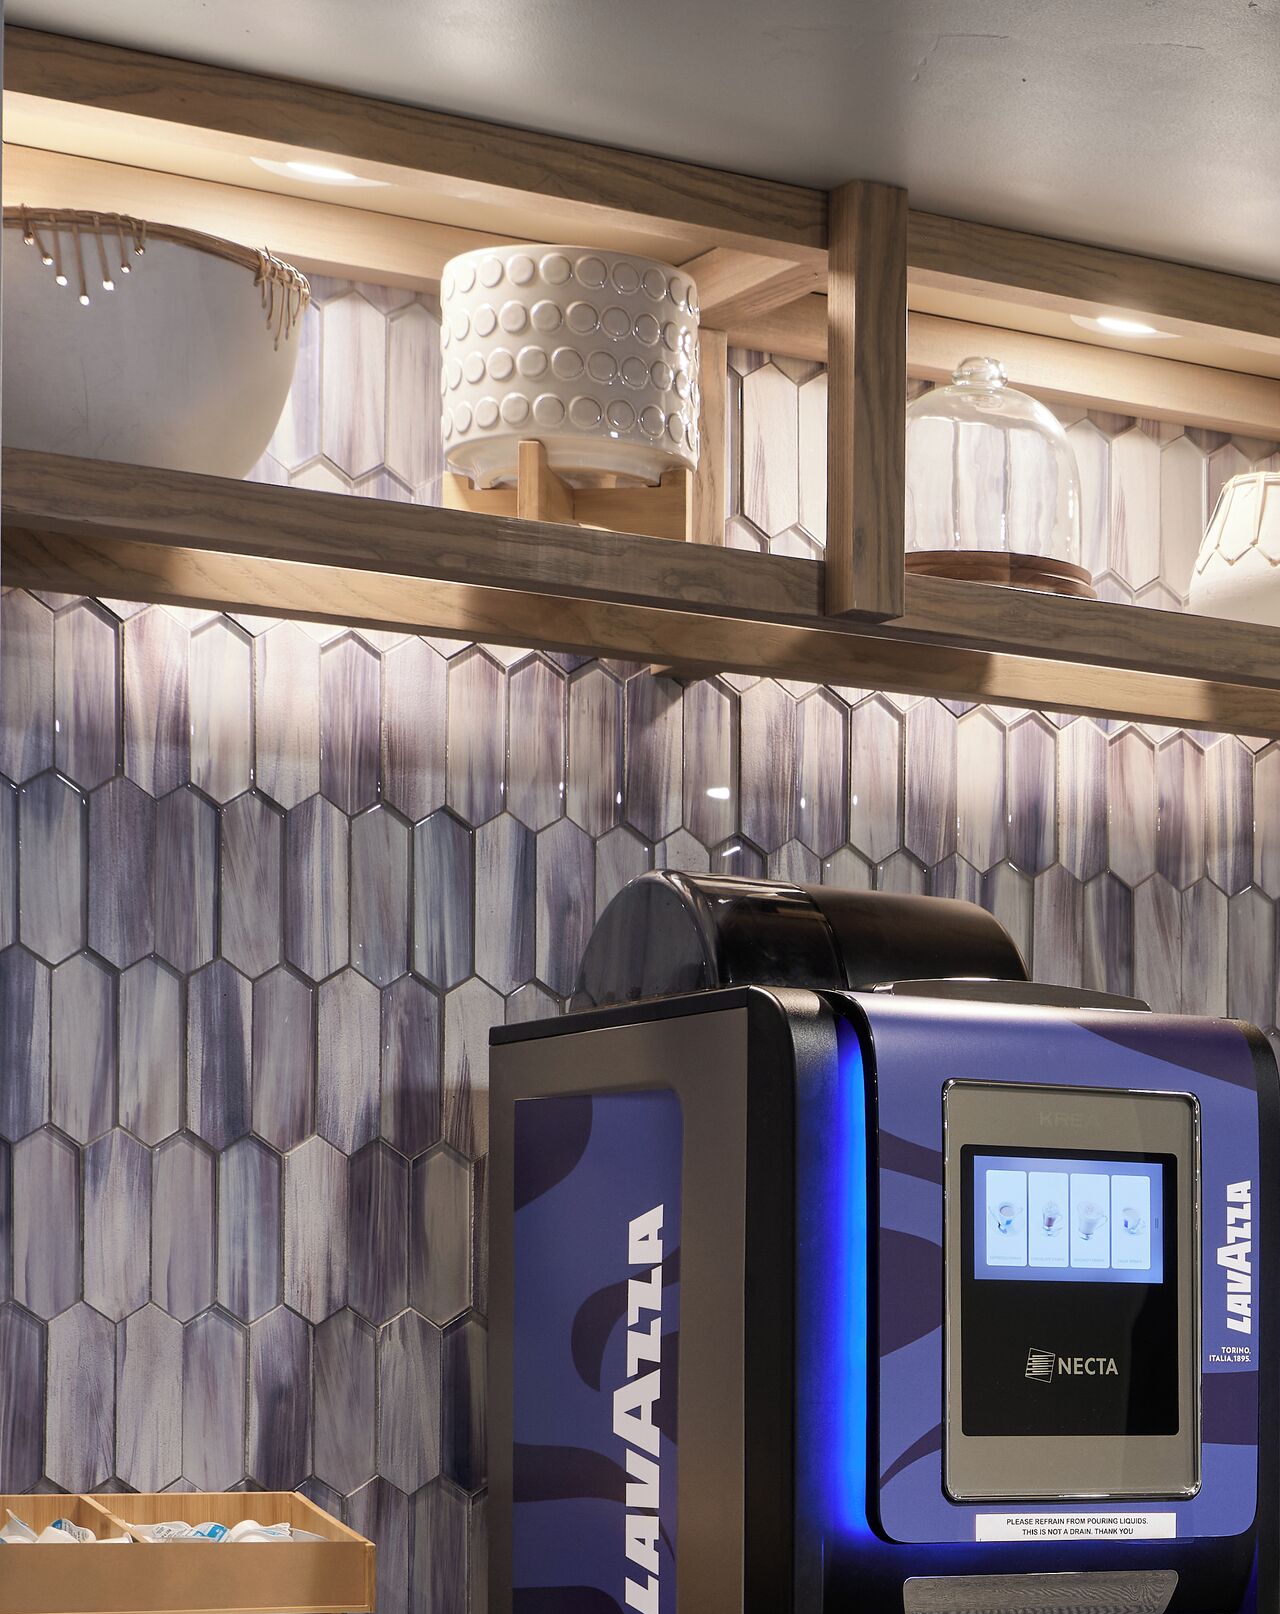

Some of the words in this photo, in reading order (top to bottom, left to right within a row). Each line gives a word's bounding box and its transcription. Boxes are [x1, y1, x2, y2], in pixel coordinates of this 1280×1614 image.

[1216, 1180, 1251, 1335] LAVAZZA
[1058, 1357, 1119, 1375] NECTA
[1006, 1518, 1034, 1526] PLEASE
[1066, 1517, 1086, 1525] FROM
[1087, 1517, 1119, 1525] POURING
[1119, 1517, 1149, 1525] LIQUIDS.
